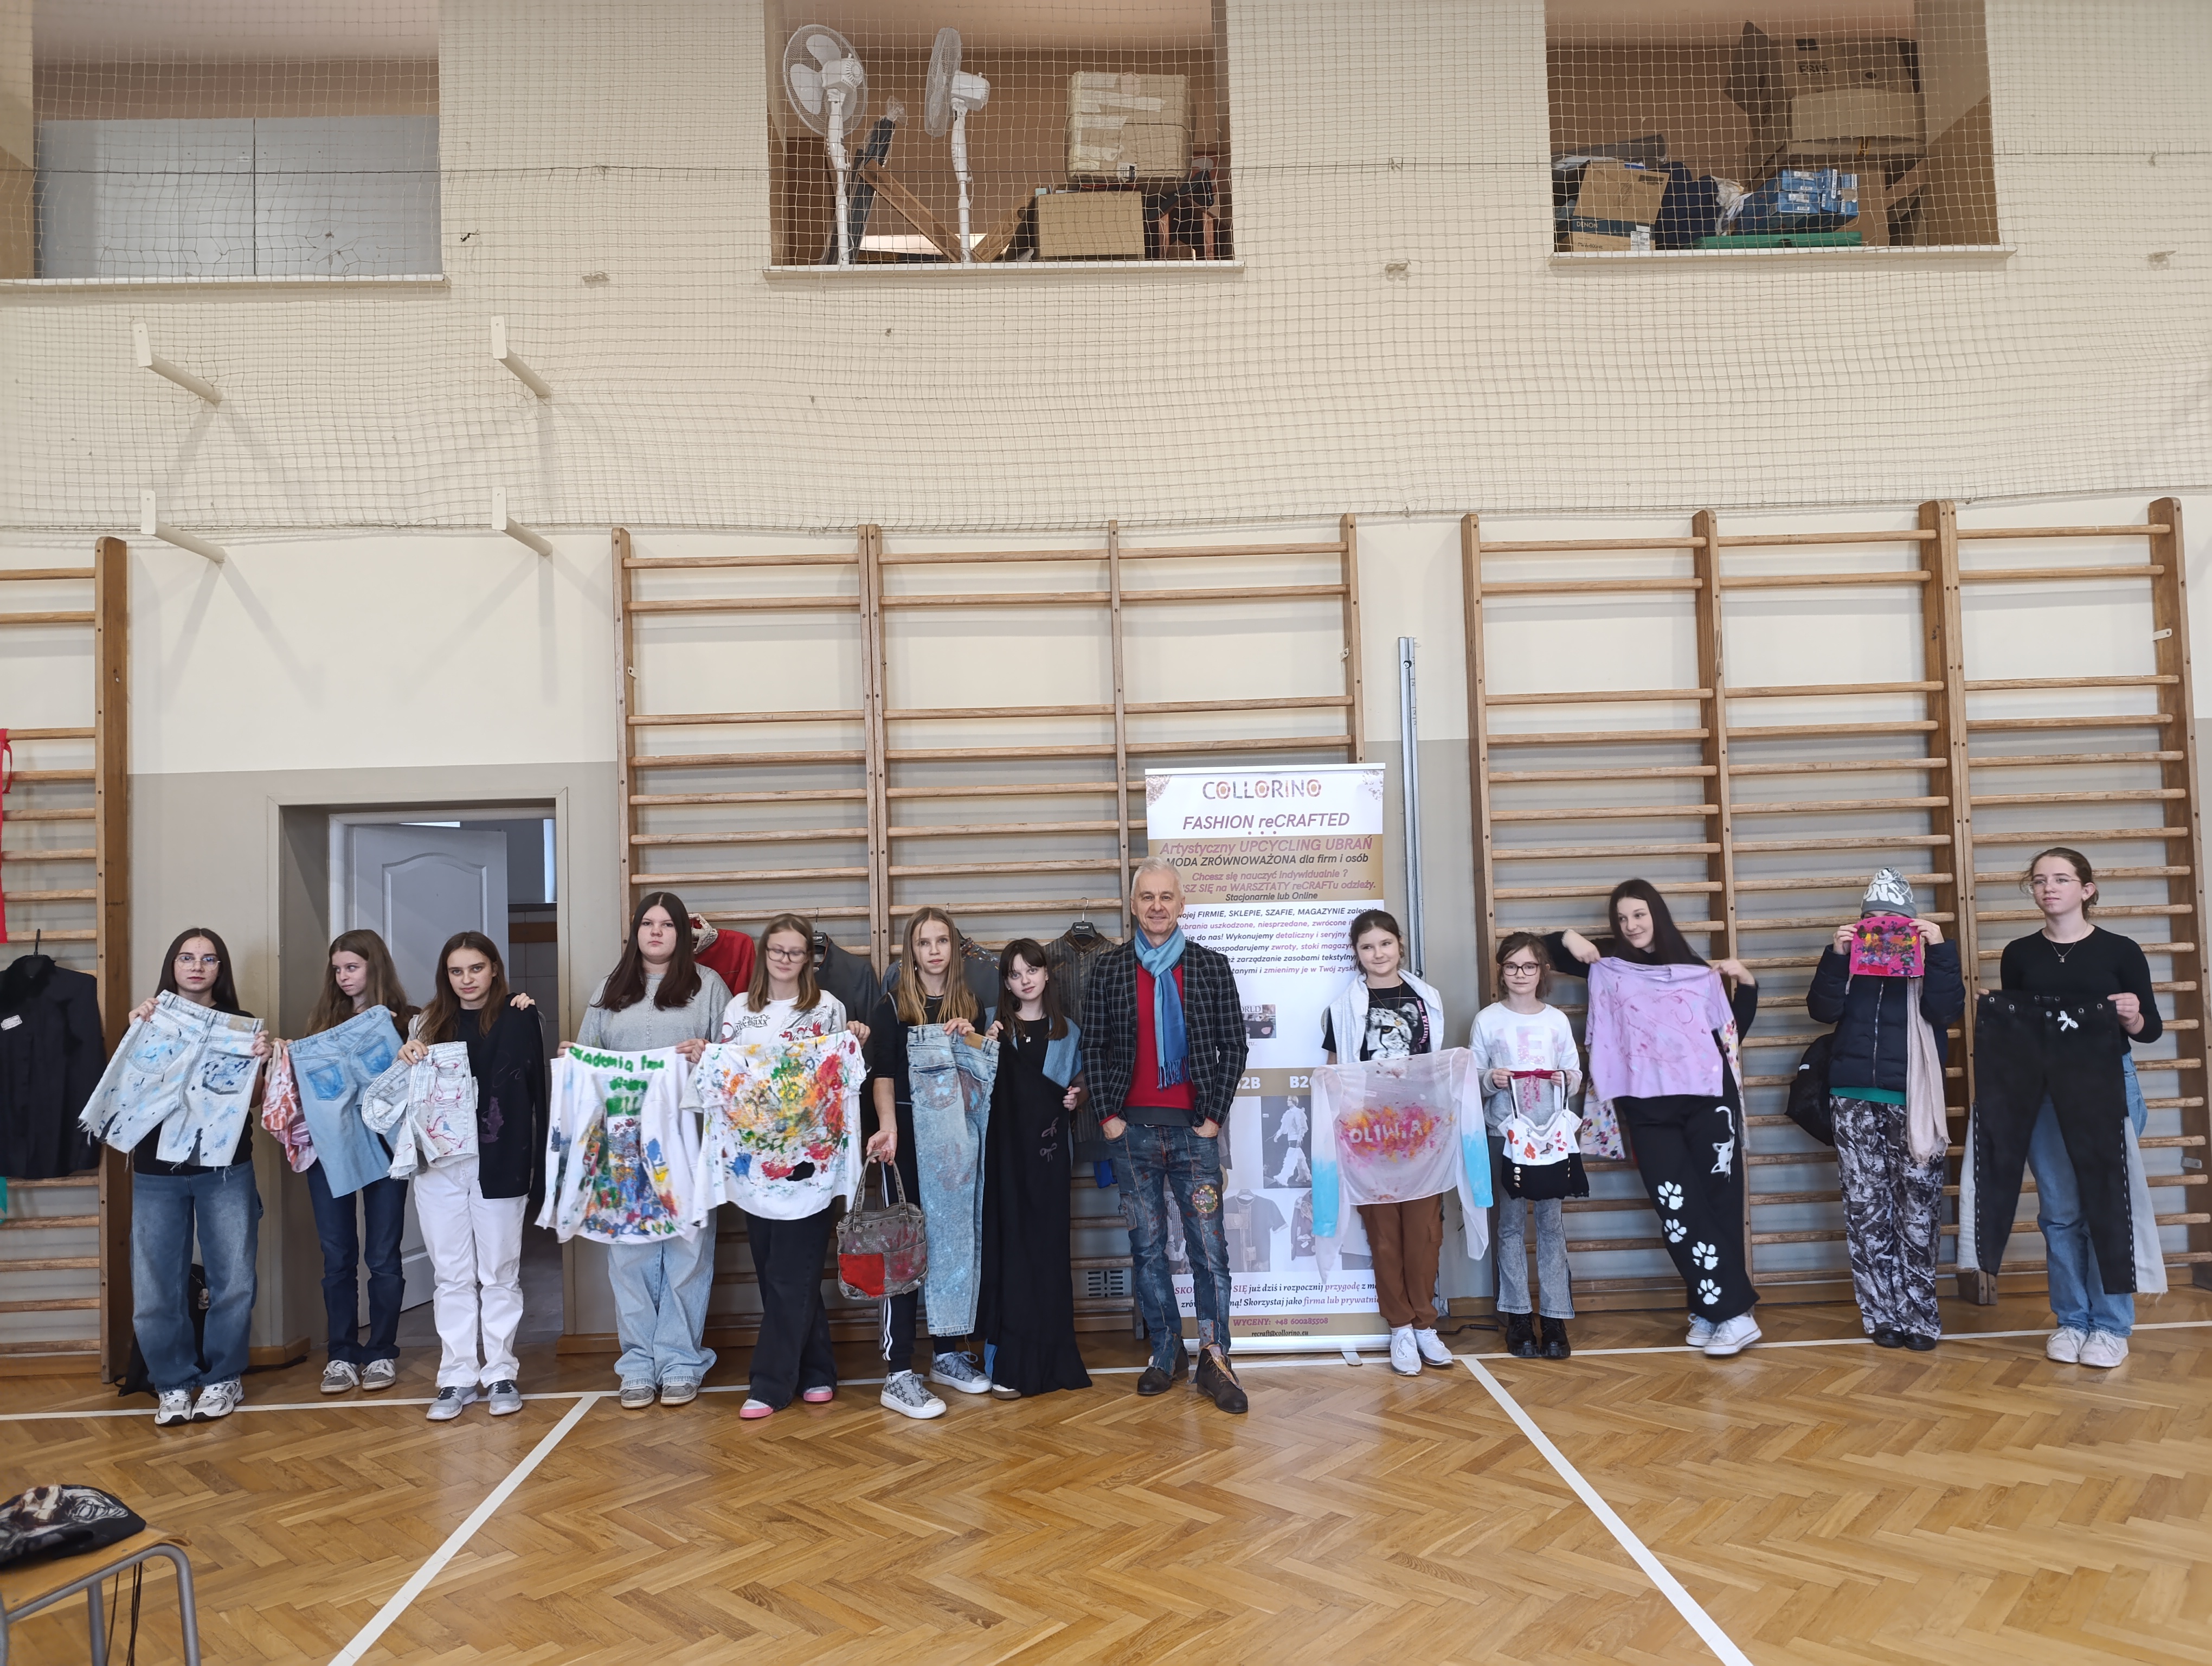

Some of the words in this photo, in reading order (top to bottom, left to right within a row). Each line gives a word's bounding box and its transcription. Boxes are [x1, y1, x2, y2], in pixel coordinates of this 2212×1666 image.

[1202, 779, 1322, 799] COLLORINO
[1183, 815, 1254, 830] FASHION
[1258, 813, 1349, 828] reCRAFTED
[1160, 842, 1236, 857] Artystyczny
[1239, 838, 1321, 852] UPCYCLING
[1326, 835, 1372, 850] UBRAŃ
[1167, 857, 1198, 867] MODA
[1200, 853, 1296, 866] ZRÓWNOWAŻONA
[1299, 855, 1315, 863] dla
[1317, 854, 1336, 863] firm
[1340, 854, 1343, 862] i
[1346, 854, 1368, 862] osób
[1192, 872, 1224, 881] Chcesz
[1226, 872, 1238, 881] się
[1240, 870, 1277, 881] nauczyć
[1343, 869, 1348, 877] ?
[1183, 884, 1197, 893] SZ
[1199, 883, 1214, 894] SIĘ
[1230, 882, 1291, 892] WARSZTATY
[1292, 881, 1339, 890] reCRAFTu
[1341, 880, 1375, 890] odzieży.
[1225, 893, 1275, 902] Stacjonarnie
[1292, 892, 1318, 900] Online
[1177, 911, 1196, 920] wojej
[1258, 920, 1309, 928] niesprzedane,
[1226, 932, 1274, 941] Wykonujemy
[1237, 956, 1282, 964] zarządzanie
[1232, 967, 1258, 975] tanymi
[1319, 966, 1336, 974] Twój
[1175, 1286, 1194, 1295] SKO
[1233, 1285, 1248, 1295] SIĘ
[1248, 1284, 1261, 1295] już
[1262, 1284, 1277, 1292] dziś
[1283, 1283, 1323, 1293] rozpocznij
[1324, 1281, 1360, 1292] przygodę
[1181, 1300, 1195, 1308] zró
[1230, 1298, 1242, 1309] ną!
[1244, 1297, 1284, 1308] Skorzystaj
[1285, 1297, 1302, 1307] jako
[1302, 1297, 1325, 1306] firma
[1233, 1318, 1271, 1327] WYCENY:
[1251, 1329, 1308, 1337] recraft@collorino.eu
